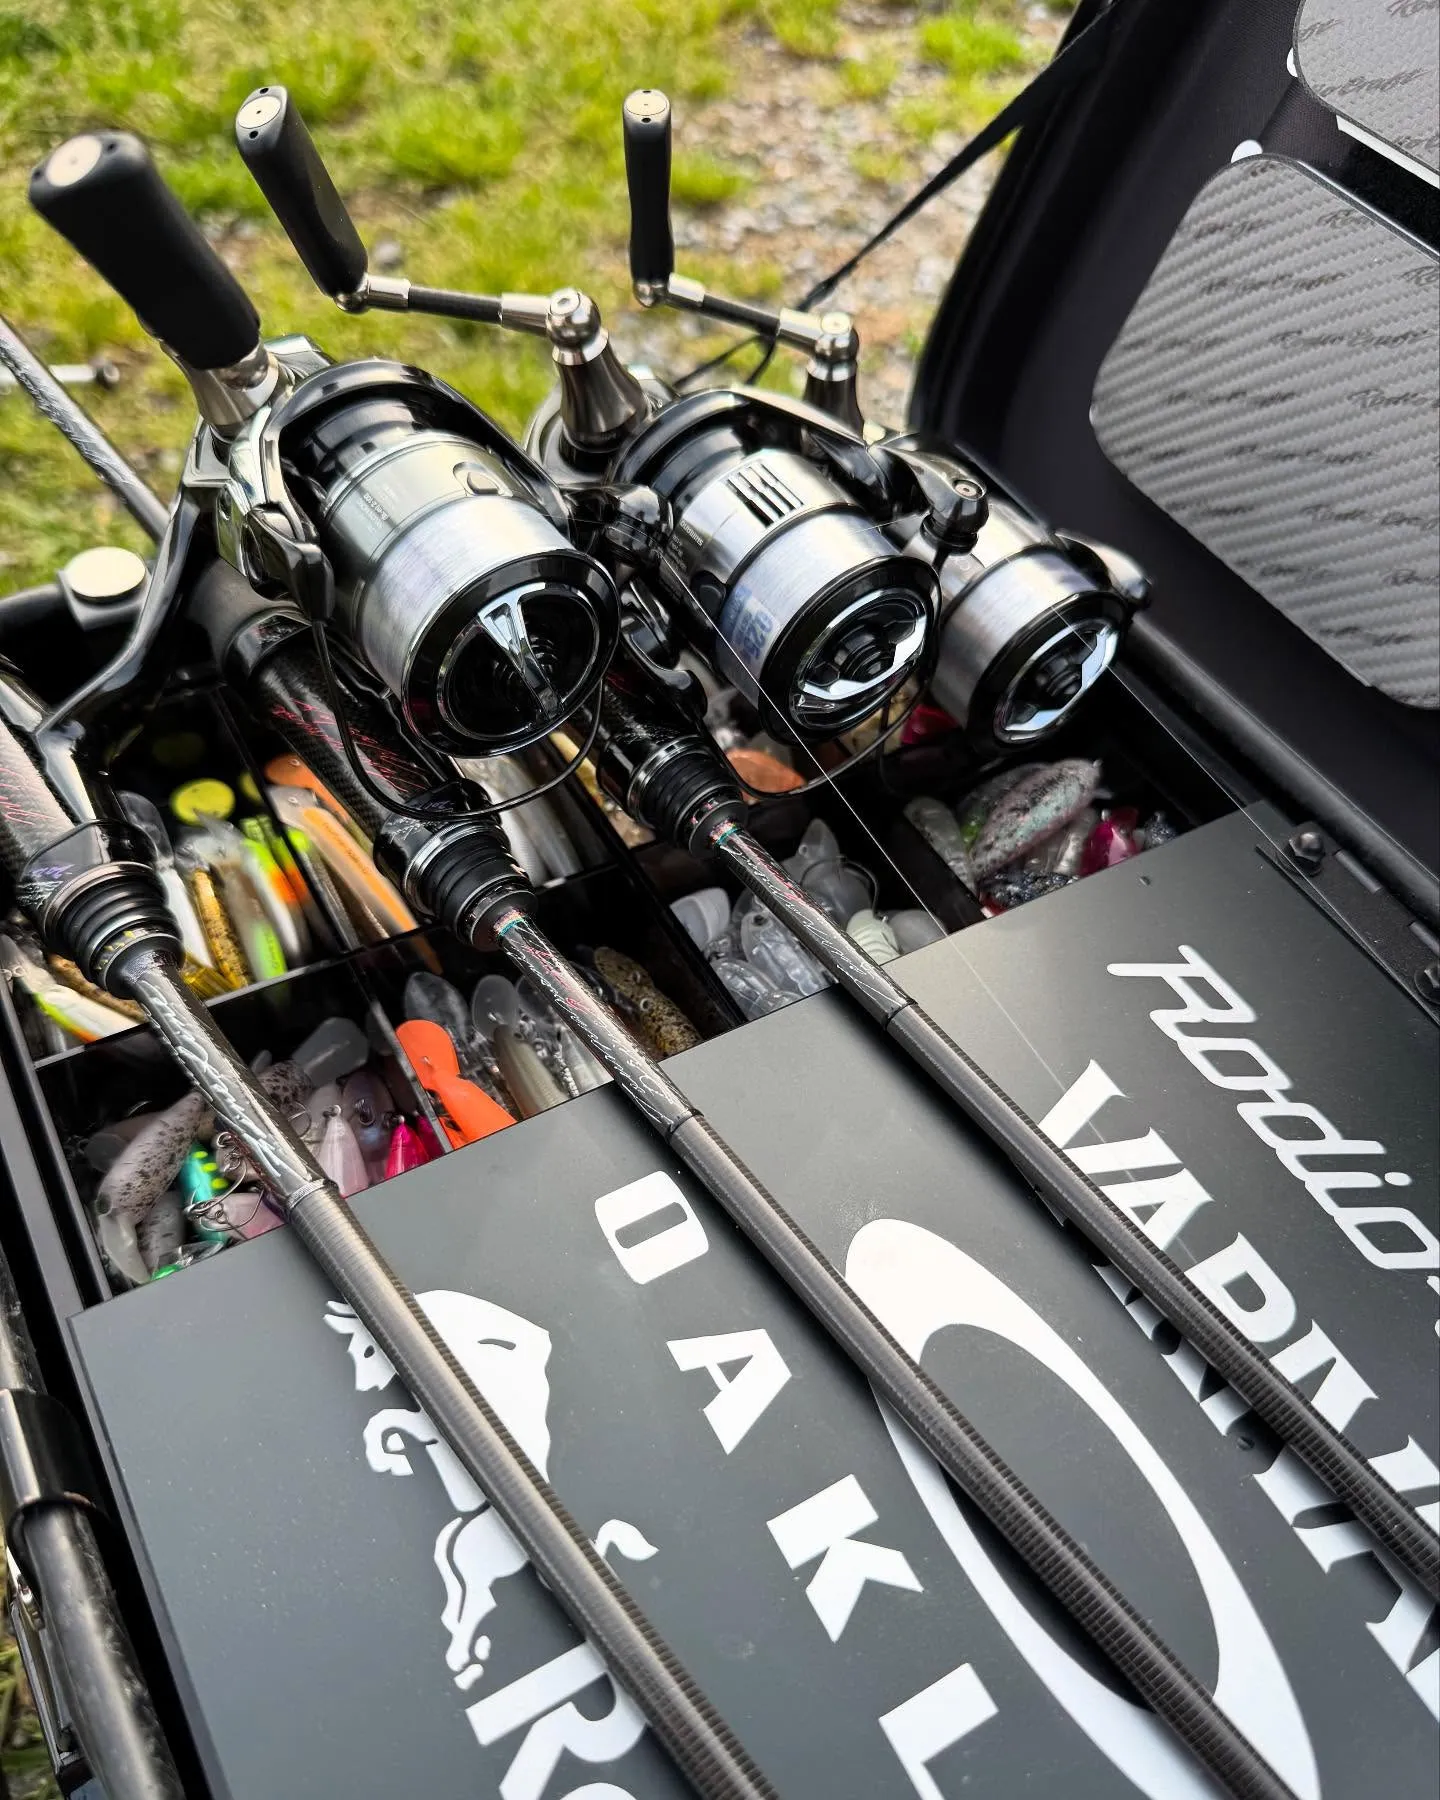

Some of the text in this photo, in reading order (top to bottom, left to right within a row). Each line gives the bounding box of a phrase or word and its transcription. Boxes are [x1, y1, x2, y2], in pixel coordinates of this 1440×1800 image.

[680, 519, 704, 547] SHIMANO
[595, 1170, 999, 1800] OAKL
[464, 1638, 653, 1800] R
